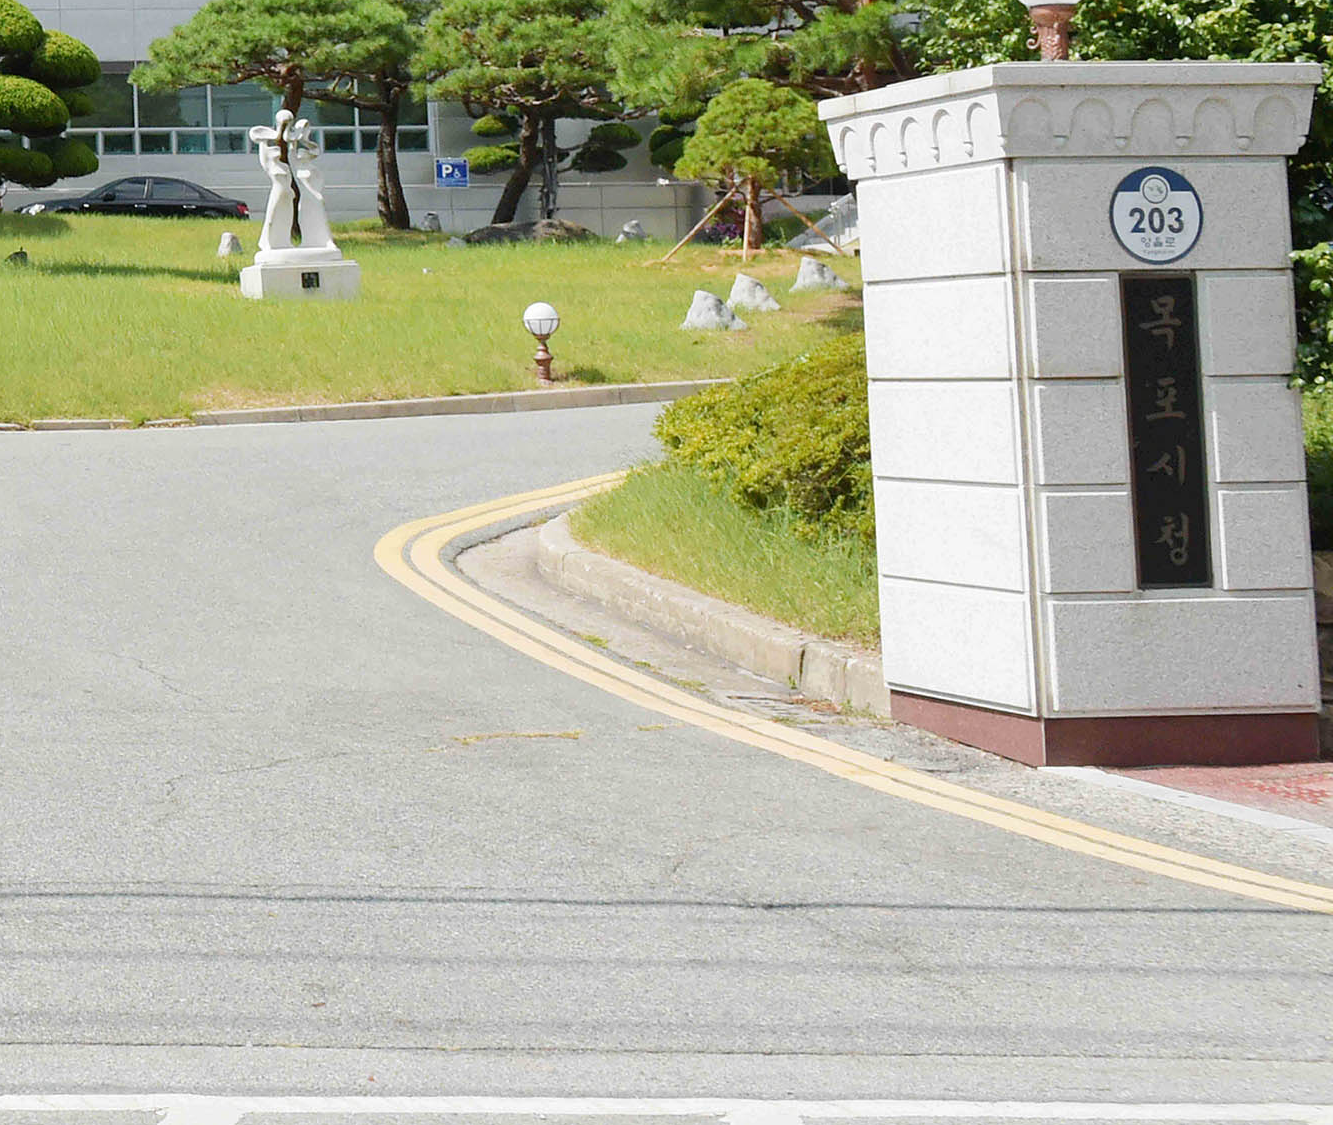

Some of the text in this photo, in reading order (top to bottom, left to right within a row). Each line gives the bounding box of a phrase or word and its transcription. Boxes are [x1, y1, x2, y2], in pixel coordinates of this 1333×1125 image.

[442, 164, 453, 178] P
[1129, 207, 1184, 234] 203
[1139, 295, 1188, 566] 목포시청
